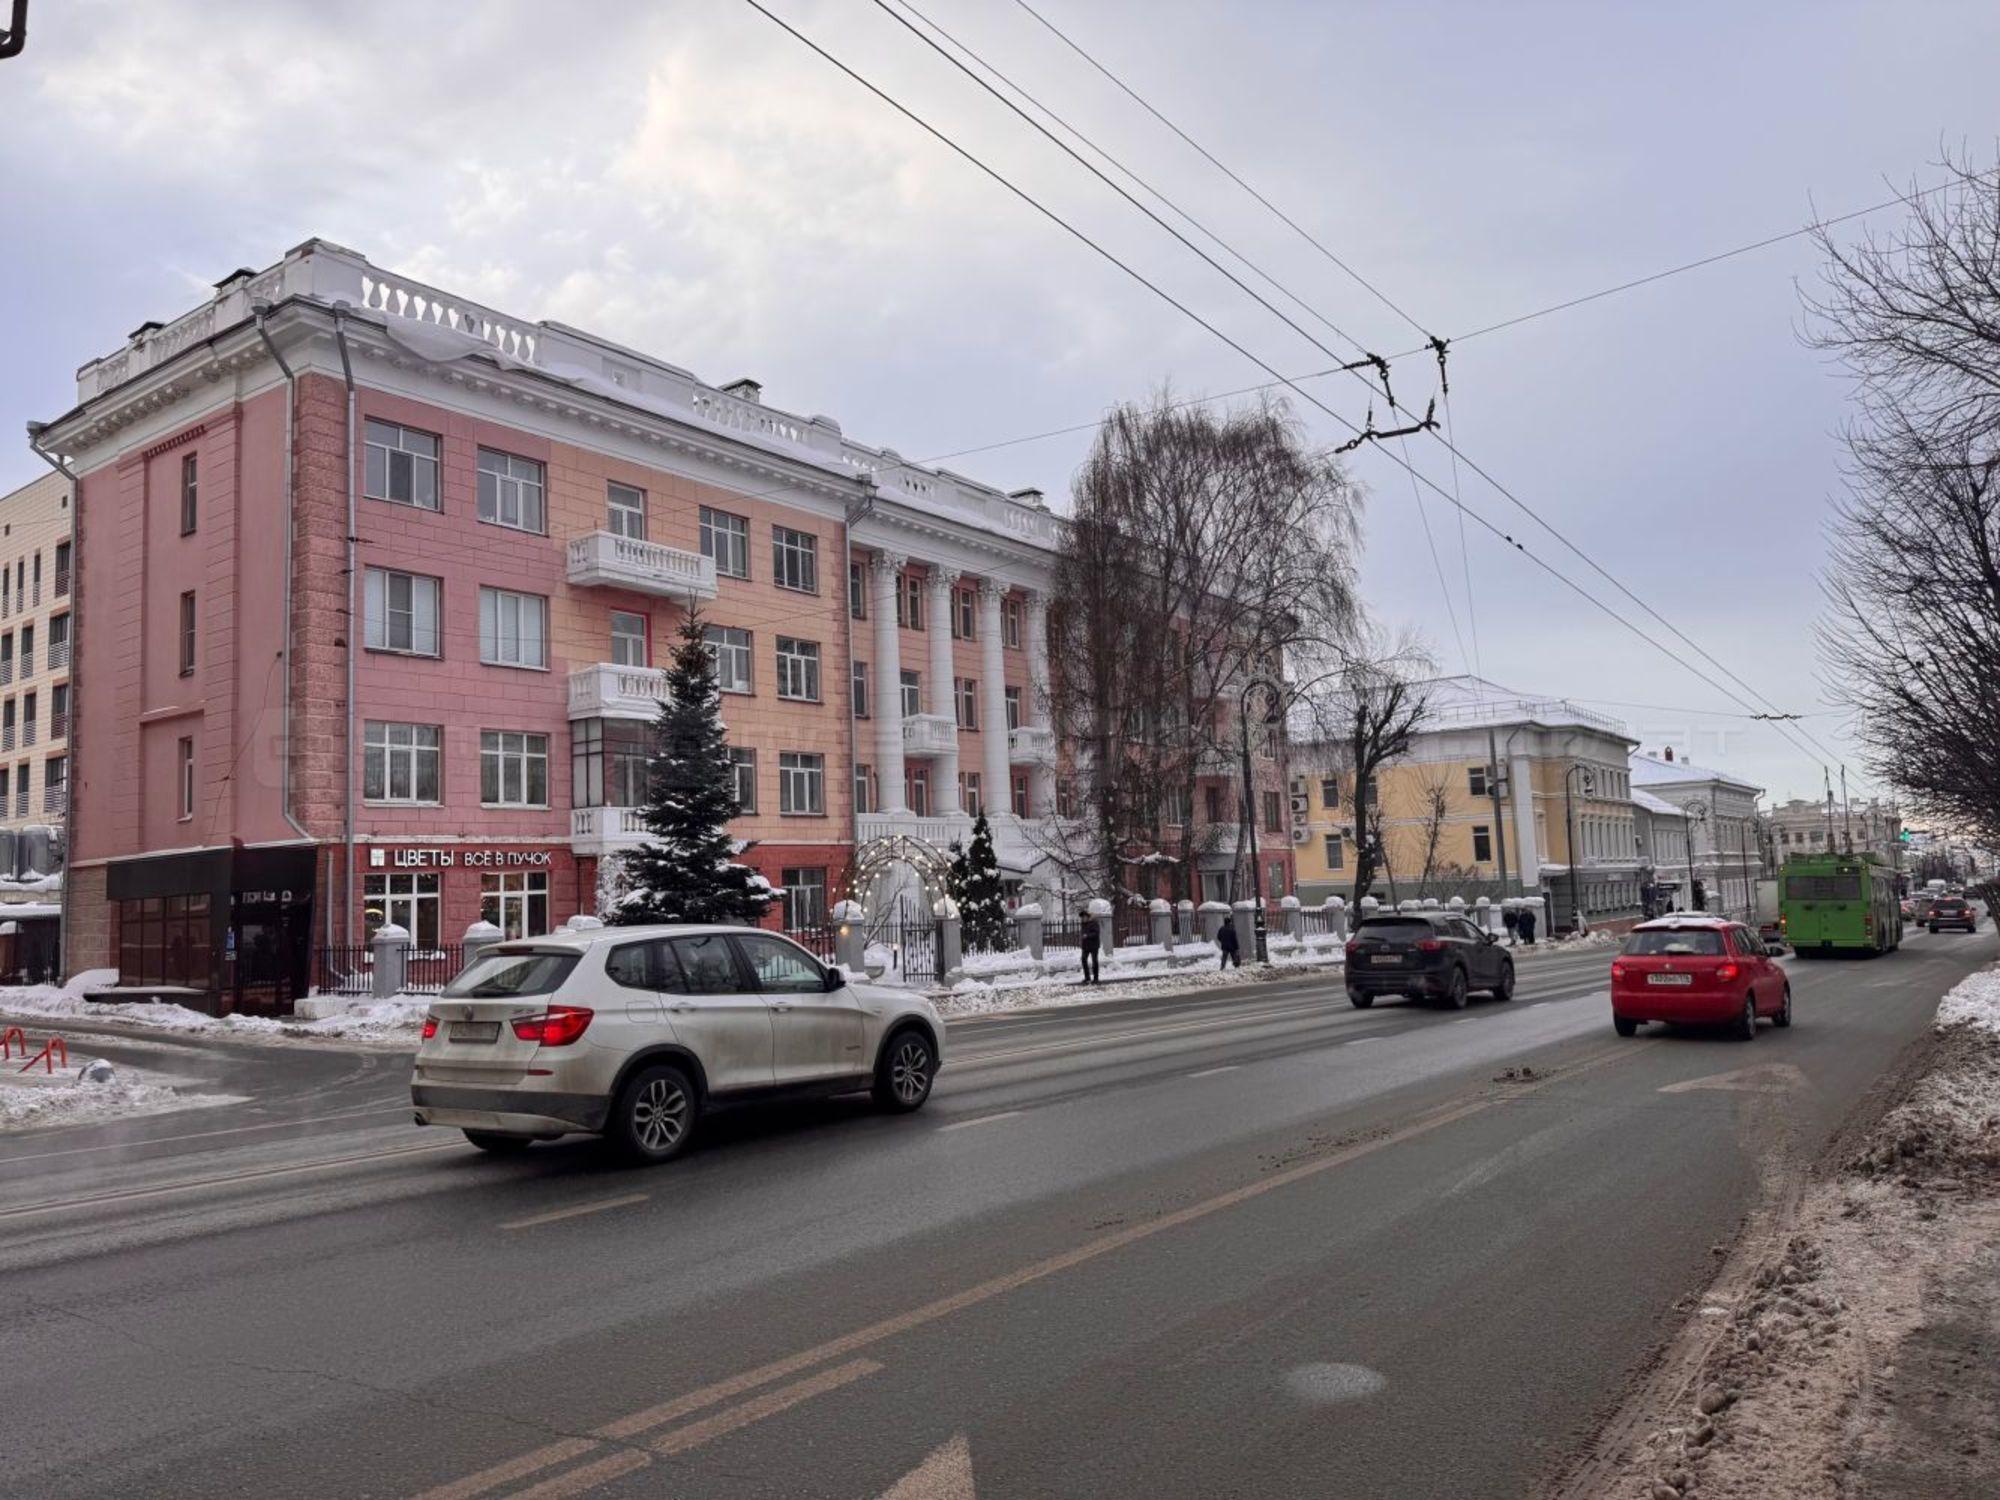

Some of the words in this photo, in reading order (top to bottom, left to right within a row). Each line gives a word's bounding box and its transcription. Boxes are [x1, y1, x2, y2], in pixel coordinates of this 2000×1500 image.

[394, 849, 454, 868] ЦВЕТЫ
[496, 851, 504, 865] В
[508, 851, 551, 865] ПУЧОК
